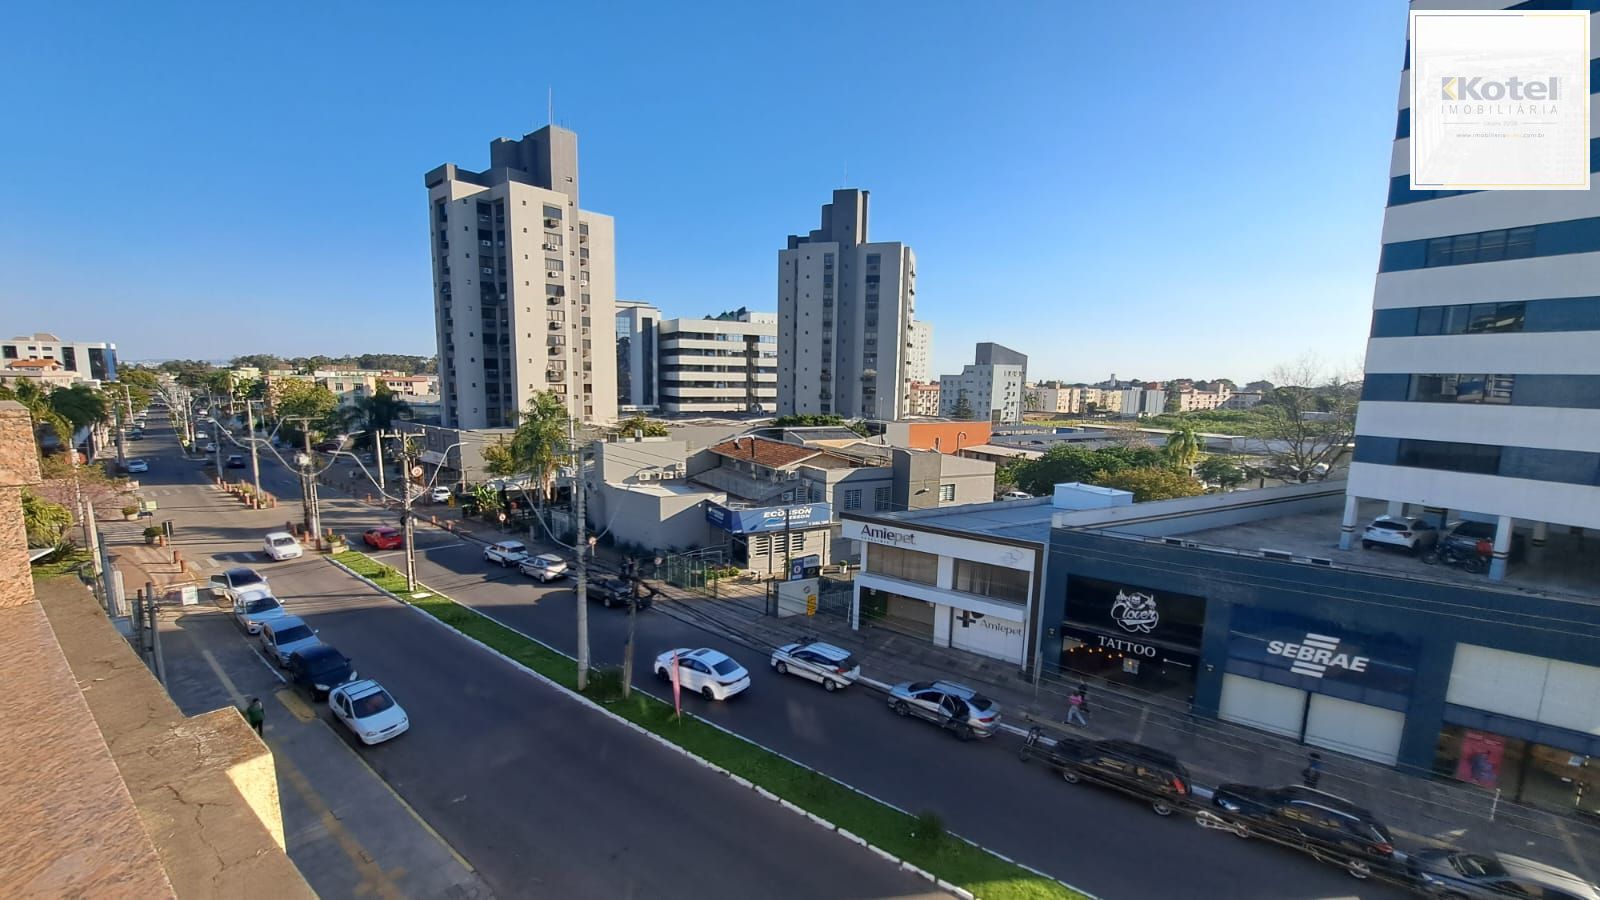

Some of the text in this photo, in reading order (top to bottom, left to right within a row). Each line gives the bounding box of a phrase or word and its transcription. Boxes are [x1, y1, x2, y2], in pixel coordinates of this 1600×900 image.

[861, 524, 915, 545] Amiepet
[980, 619, 1022, 638] Amiepet
[1098, 635, 1156, 658] TATTOO
[1266, 640, 1370, 672] SEBRAE
